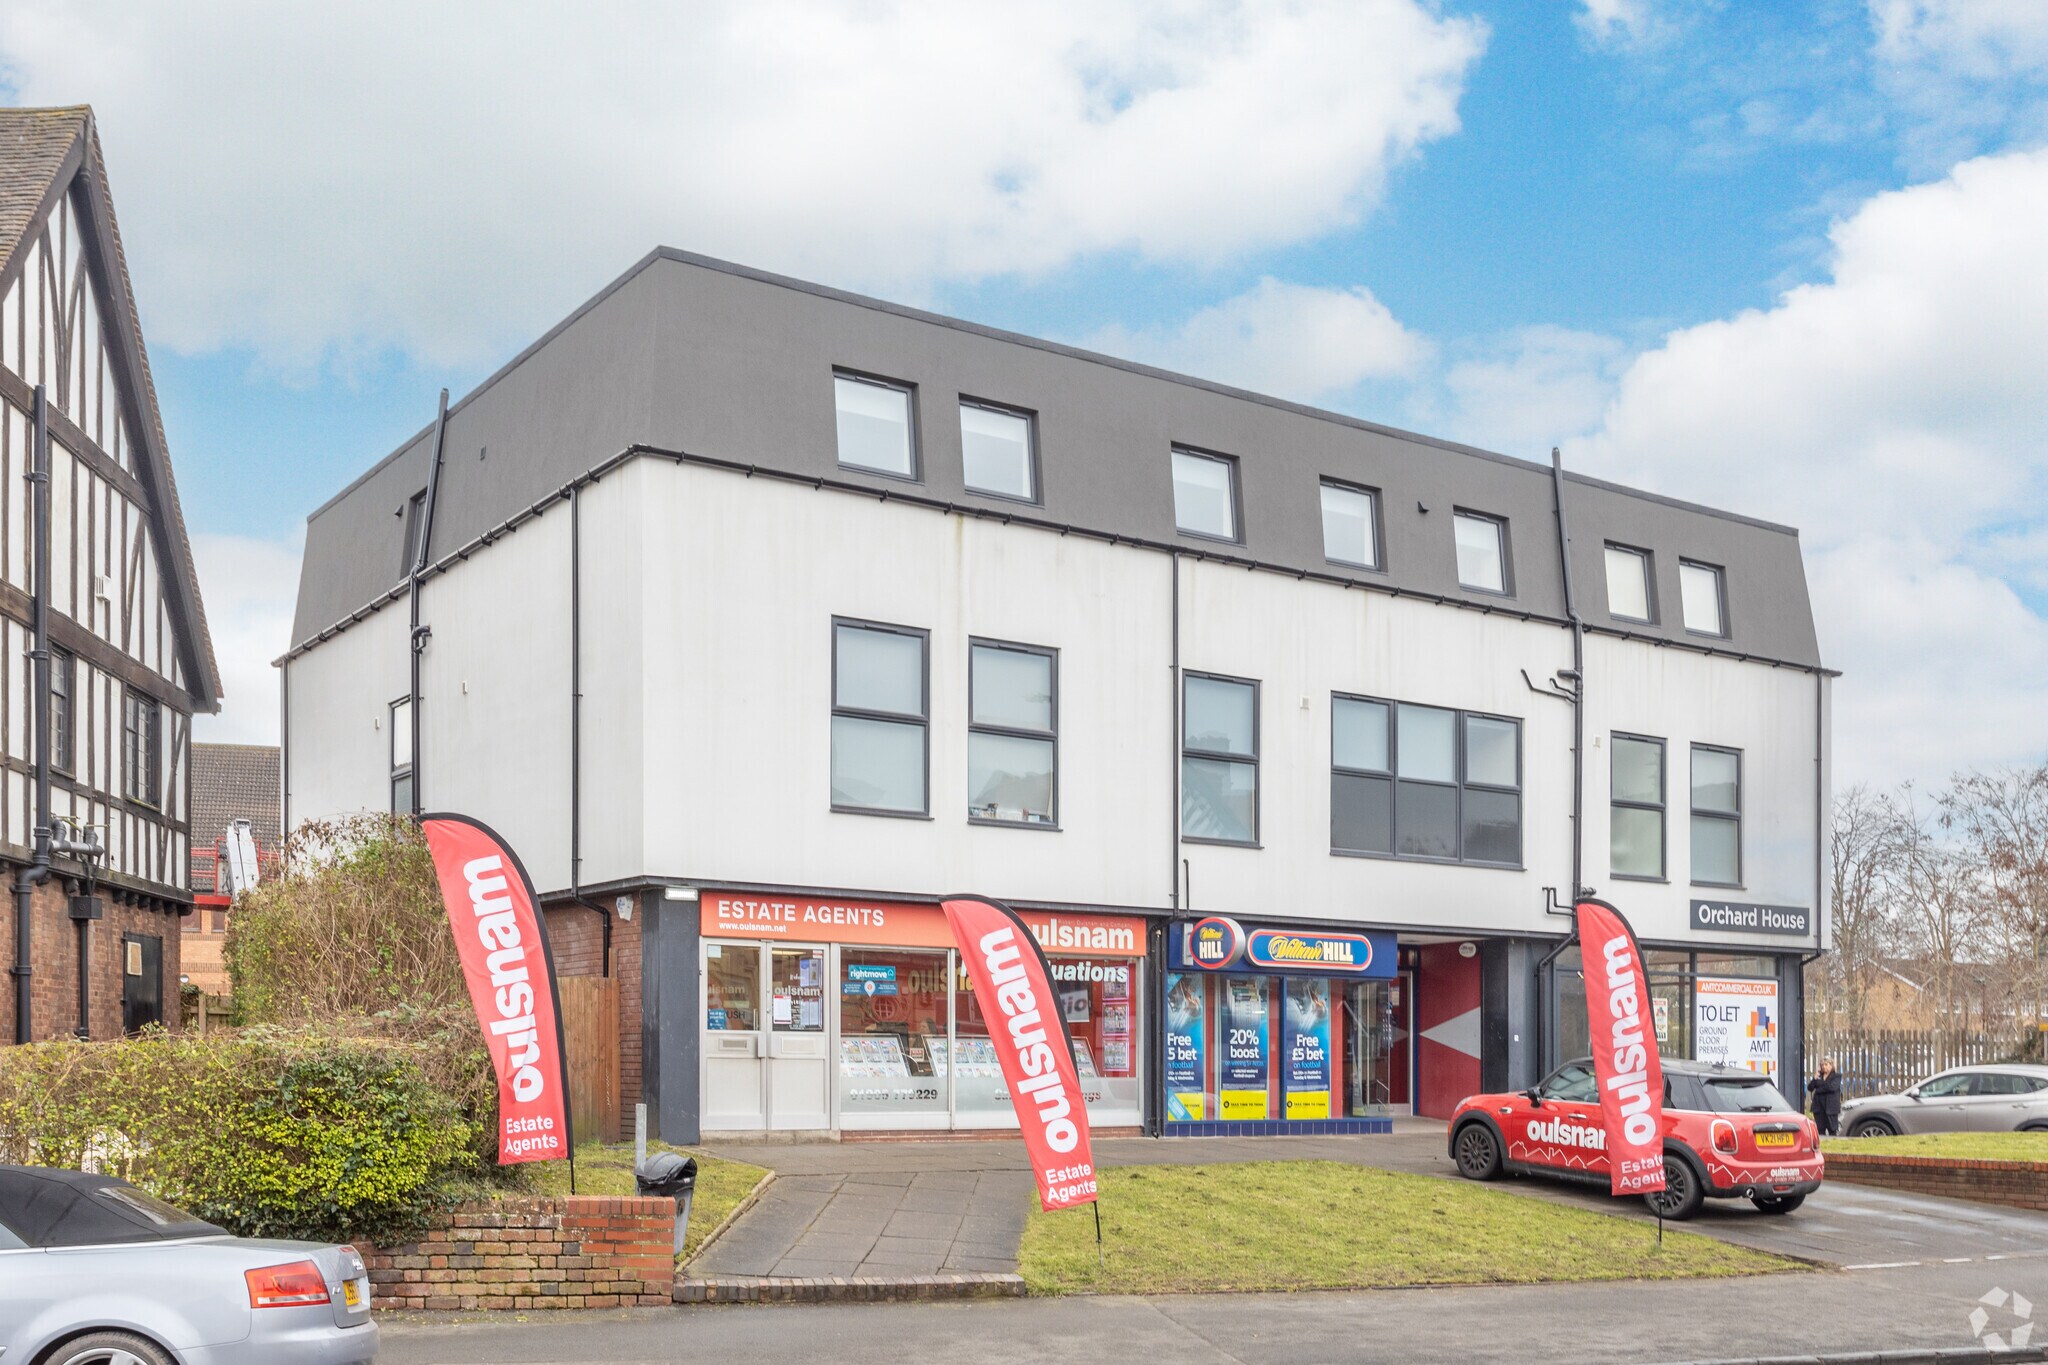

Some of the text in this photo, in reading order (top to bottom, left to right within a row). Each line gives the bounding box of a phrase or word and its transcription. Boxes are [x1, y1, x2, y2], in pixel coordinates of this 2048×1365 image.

[718, 900, 885, 927] ESTATE AGENTS
[1699, 904, 1805, 930] Orchard House
[719, 922, 787, 933] www.oulsnam.net
[1028, 918, 1134, 950] ulsnam
[1200, 941, 1224, 959] HILL
[1268, 935, 1354, 962] William HILL
[463, 854, 544, 1103] oulsnam
[850, 969, 888, 980] rightmove
[908, 961, 974, 993] oulsn
[1048, 960, 1128, 982] uations
[774, 985, 821, 997] oulsnam
[1701, 982, 1771, 994] AMTCOMMERCIAL.CO.UK
[726, 1009, 745, 1020] USH
[1700, 1005, 1740, 1022] TO LET
[1230, 1029, 1259, 1045] 20%
[1699, 1026, 1727, 1036] GROUND
[979, 926, 1079, 1154] oulsnam
[1168, 1033, 1192, 1046] Free
[1296, 1034, 1319, 1047] Free
[1603, 934, 1656, 1146] oulsnam
[1699, 1036, 1720, 1045] FLOOR
[1750, 1040, 1771, 1053] AMT
[1168, 1047, 1197, 1060] 5 bet
[1230, 1046, 1259, 1059] boost
[1292, 1047, 1324, 1061] £5 bet
[1699, 1046, 1729, 1055] PREMISES
[1172, 1061, 1194, 1069] football
[506, 1115, 553, 1134] Estate
[504, 1134, 558, 1155] Agents
[1046, 1163, 1091, 1185] Estate
[1770, 1166, 1800, 1177] oulsnam
[1620, 1171, 1666, 1189] Agent
[1047, 1180, 1097, 1203] Agents
